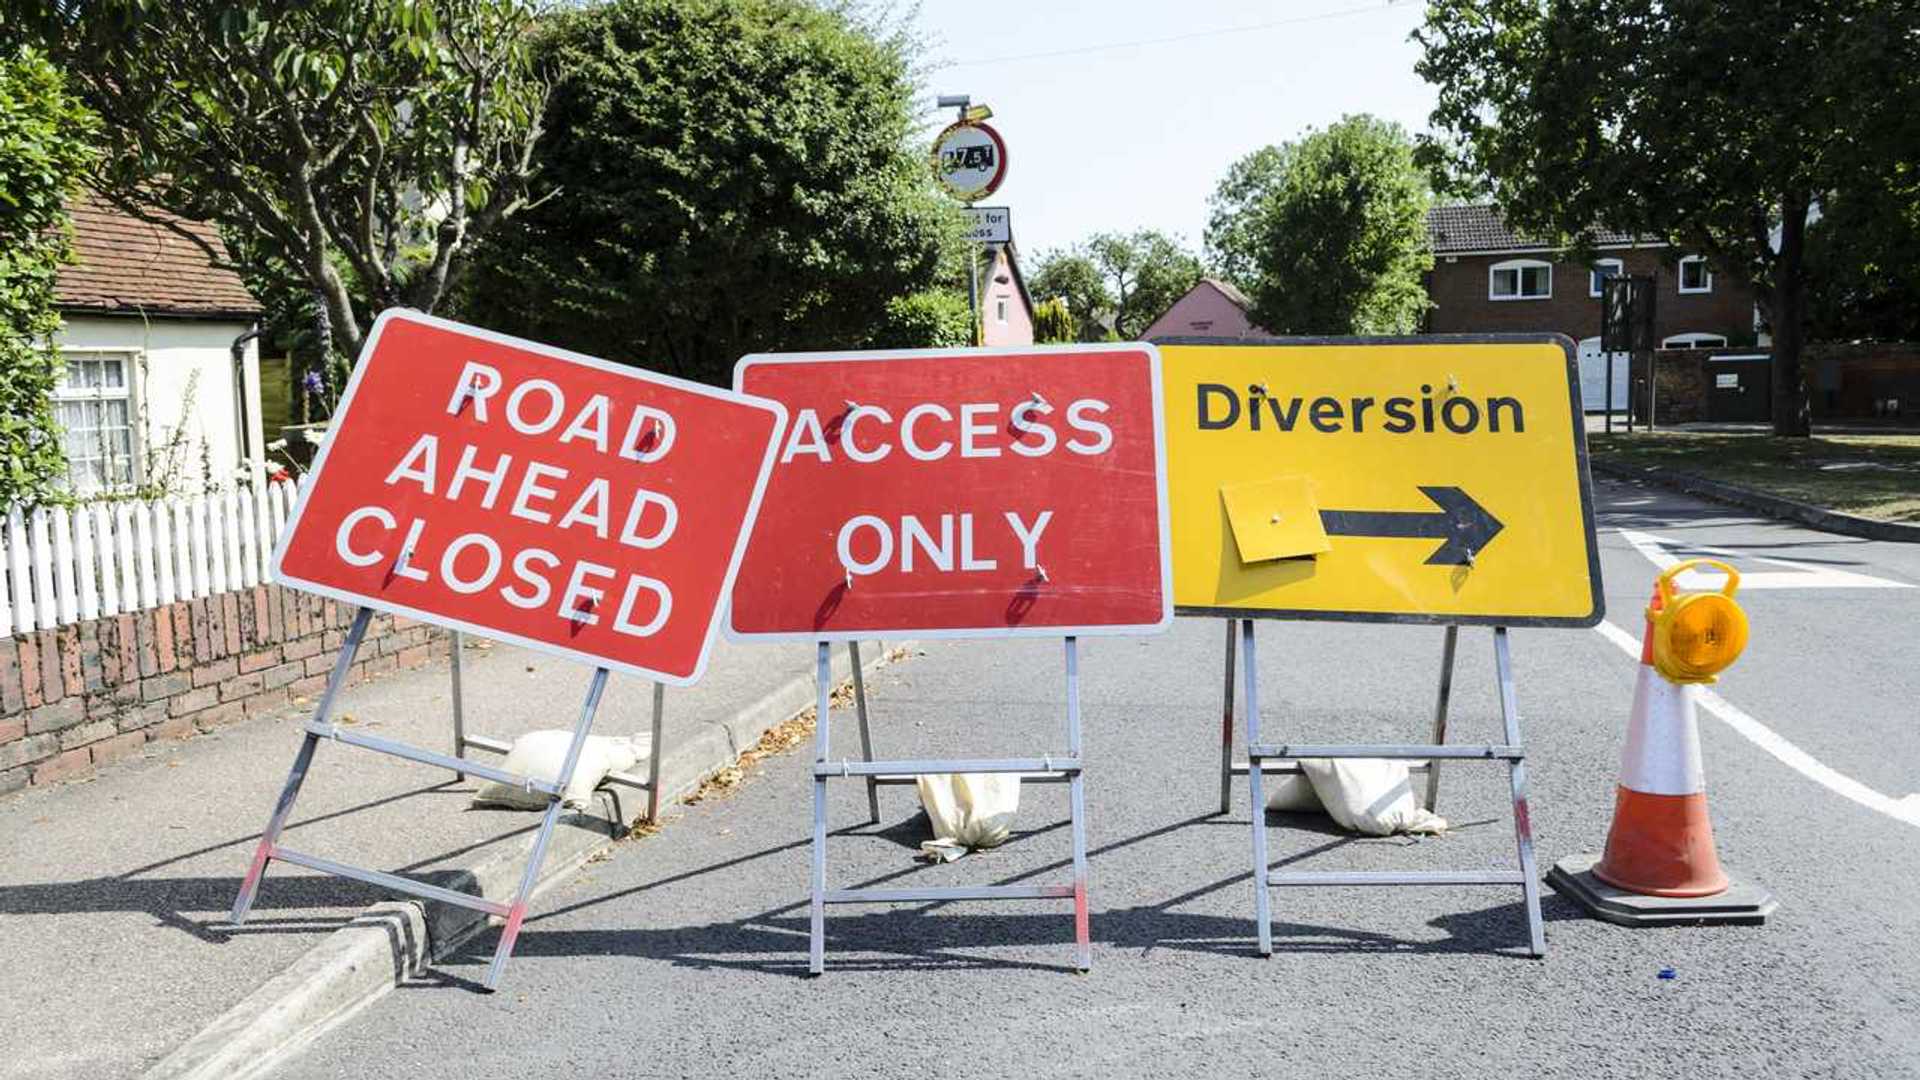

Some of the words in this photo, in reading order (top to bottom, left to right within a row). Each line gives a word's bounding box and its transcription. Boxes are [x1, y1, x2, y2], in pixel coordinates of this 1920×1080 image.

[986, 213, 1001, 224] for
[447, 361, 677, 464] ROAD
[781, 399, 1114, 463] ACCESS
[1198, 383, 1524, 434] Diversion
[385, 434, 679, 550] AHEAD
[336, 506, 673, 638] CLOSED
[837, 511, 1053, 576] ONLY
